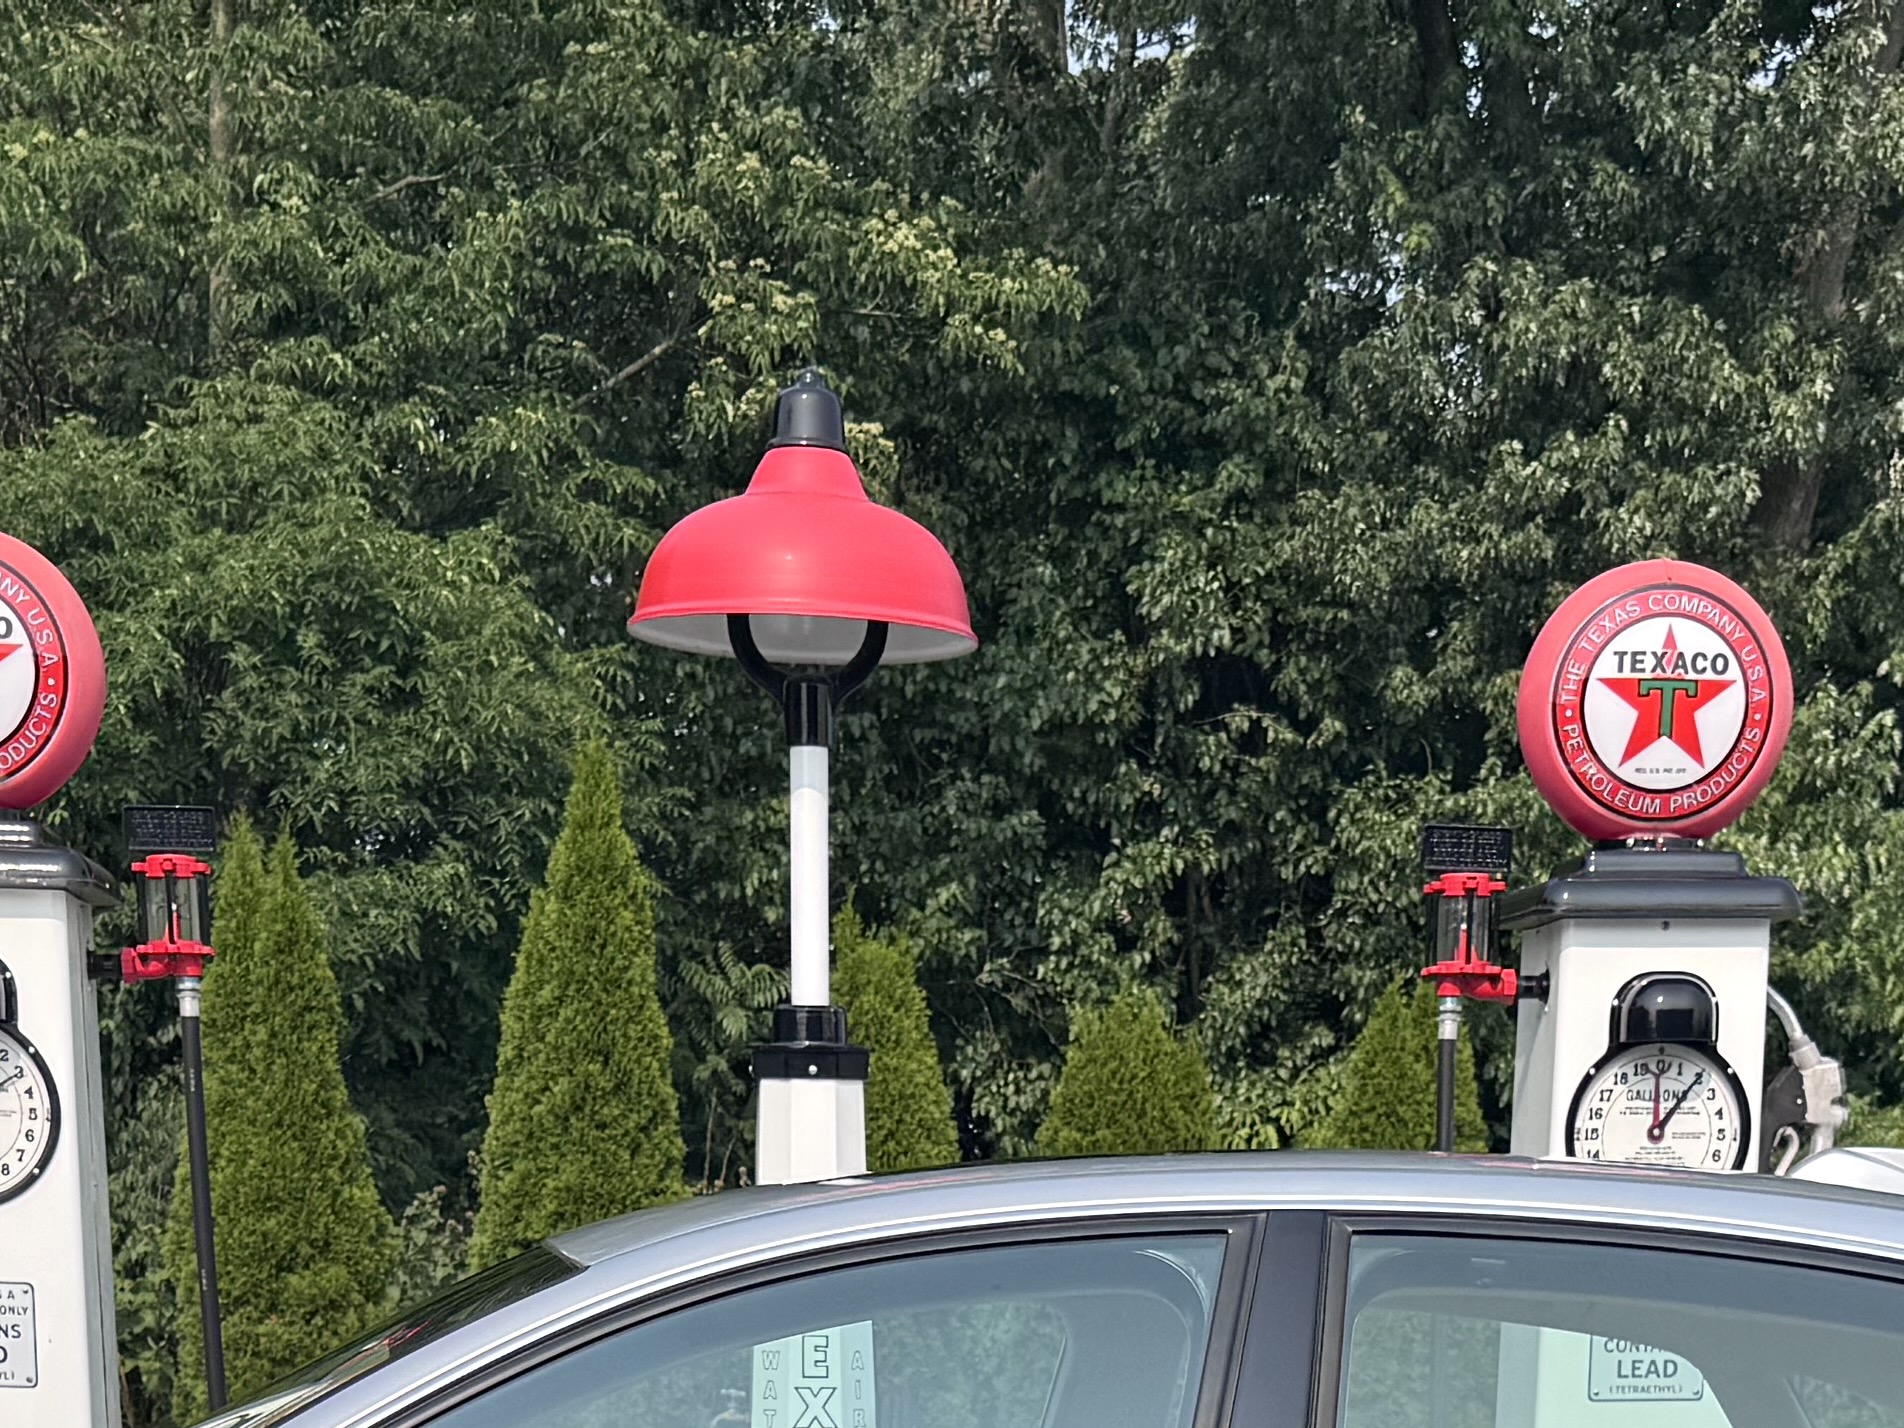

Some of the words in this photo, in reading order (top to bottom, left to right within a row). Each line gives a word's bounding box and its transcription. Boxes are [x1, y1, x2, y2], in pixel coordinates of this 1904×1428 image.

[1561, 659, 1585, 704] THE
[1579, 601, 1641, 653] TEXAS
[1648, 593, 1745, 641] COMPANY
[1613, 651, 1729, 675] TEXACO
[1563, 725, 1660, 814] PETROLEUM
[1669, 728, 1760, 812] PRODUCTS
[0, 1049, 9, 1062] 2
[14, 1066, 24, 1079] 3
[1677, 1062, 1683, 1076] 1
[1614, 1072, 1628, 1085] 18
[24, 1086, 34, 1099] 4
[1599, 1090, 1613, 1102] 17
[1707, 1088, 1716, 1101] 3
[29, 1108, 37, 1120] 5
[1589, 1108, 1603, 1120] 16
[1715, 1107, 1723, 1120] 4
[25, 1130, 35, 1142] 6
[1584, 1128, 1599, 1141] 15
[1717, 1129, 1725, 1140] 5
[16, 1149, 25, 1162] 7
[1712, 1150, 1721, 1162] 6
[1, 1164, 10, 1176] 8
[7, 1290, 15, 1300] A
[0, 1305, 28, 1316] ONLY
[1617, 1359, 1678, 1379] LEAD
